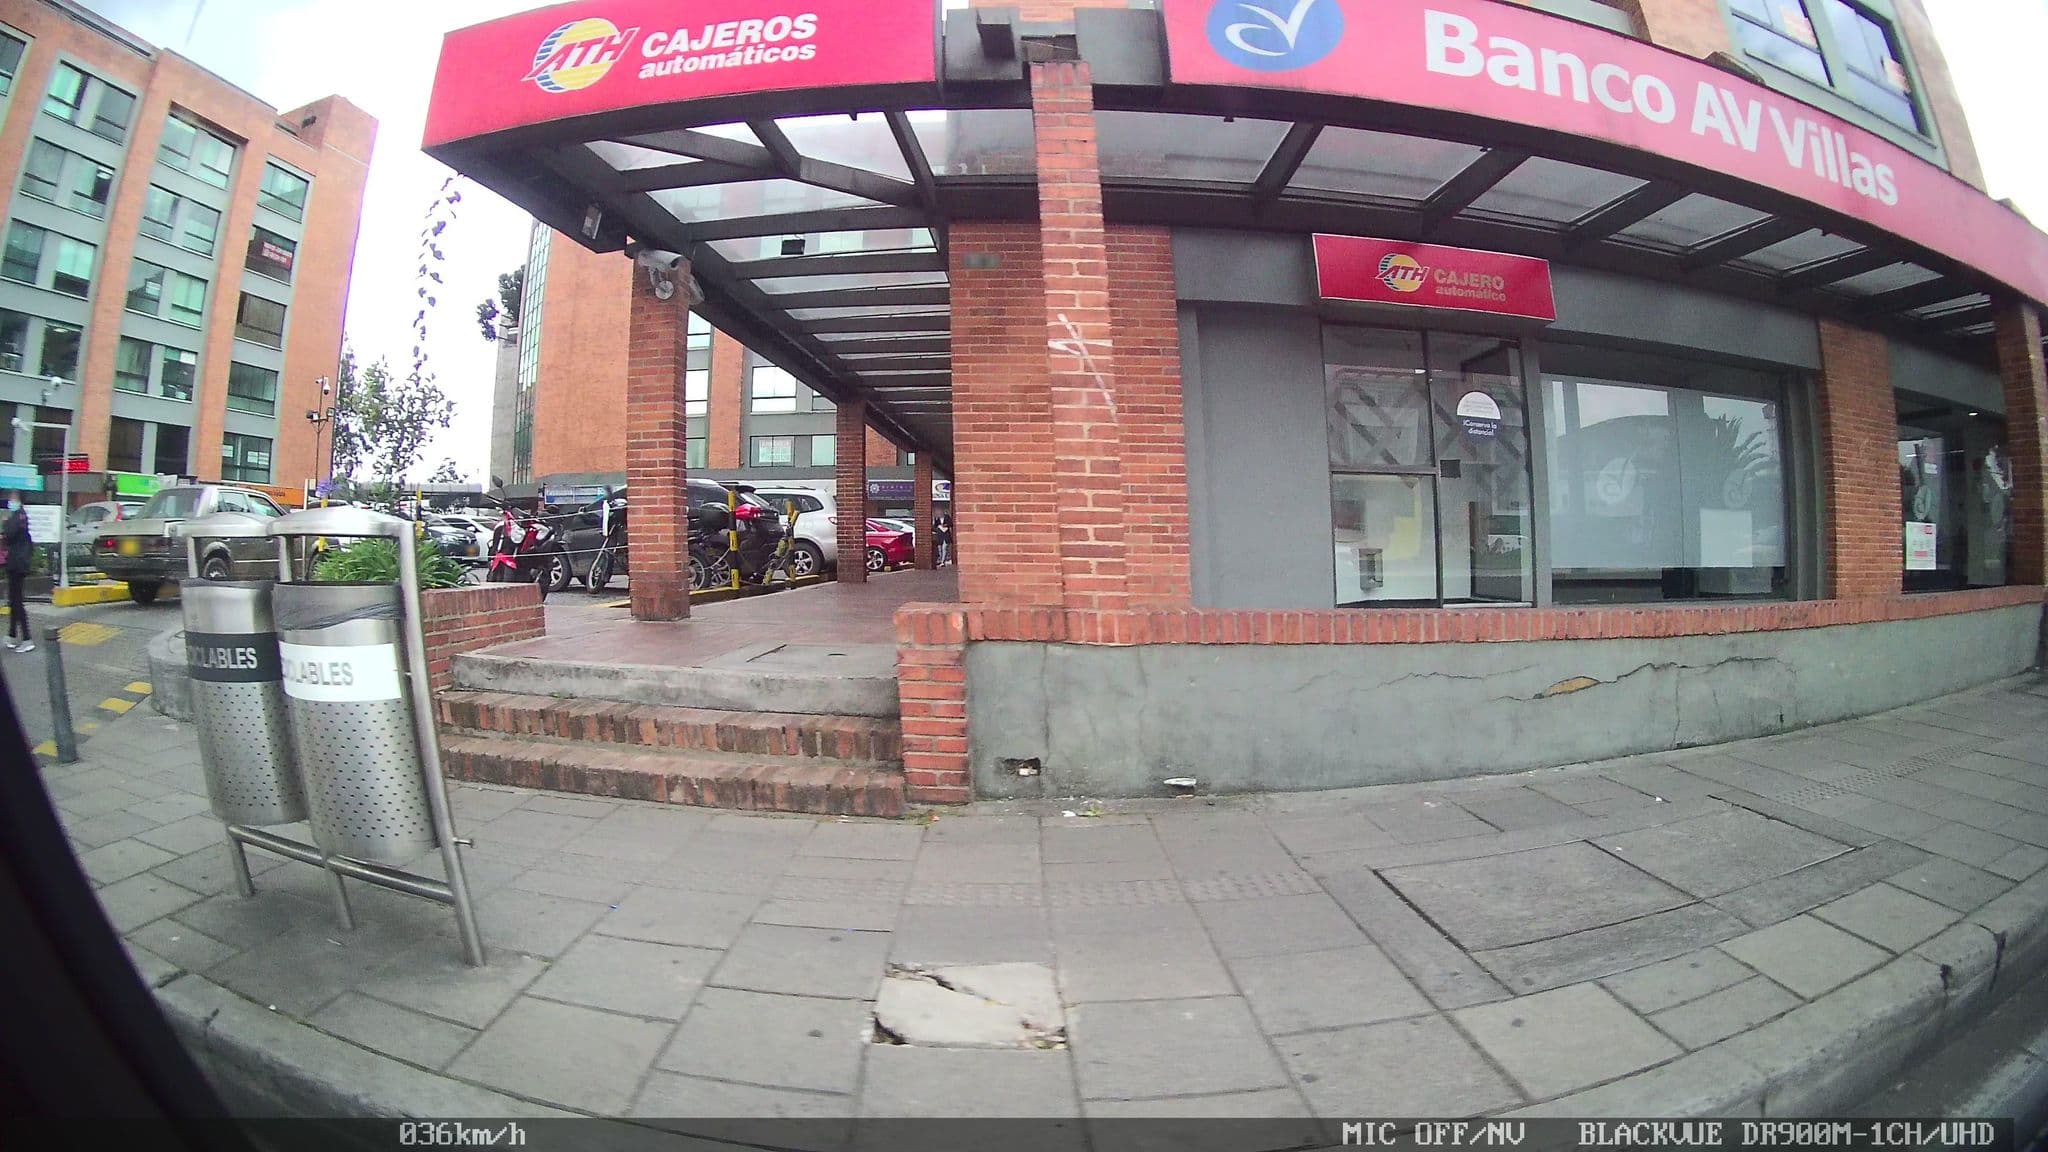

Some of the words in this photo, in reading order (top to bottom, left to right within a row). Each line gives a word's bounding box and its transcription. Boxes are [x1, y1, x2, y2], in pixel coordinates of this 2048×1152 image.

[521, 26, 640, 82] ATH
[641, 13, 818, 58] CAJEROS
[638, 43, 816, 80] automáticos
[1423, 8, 1677, 125] Banco
[1690, 77, 1763, 153] AV
[1768, 106, 1899, 207] Villas
[1375, 266, 1430, 284] ATH
[1434, 269, 1505, 290] CAJERO
